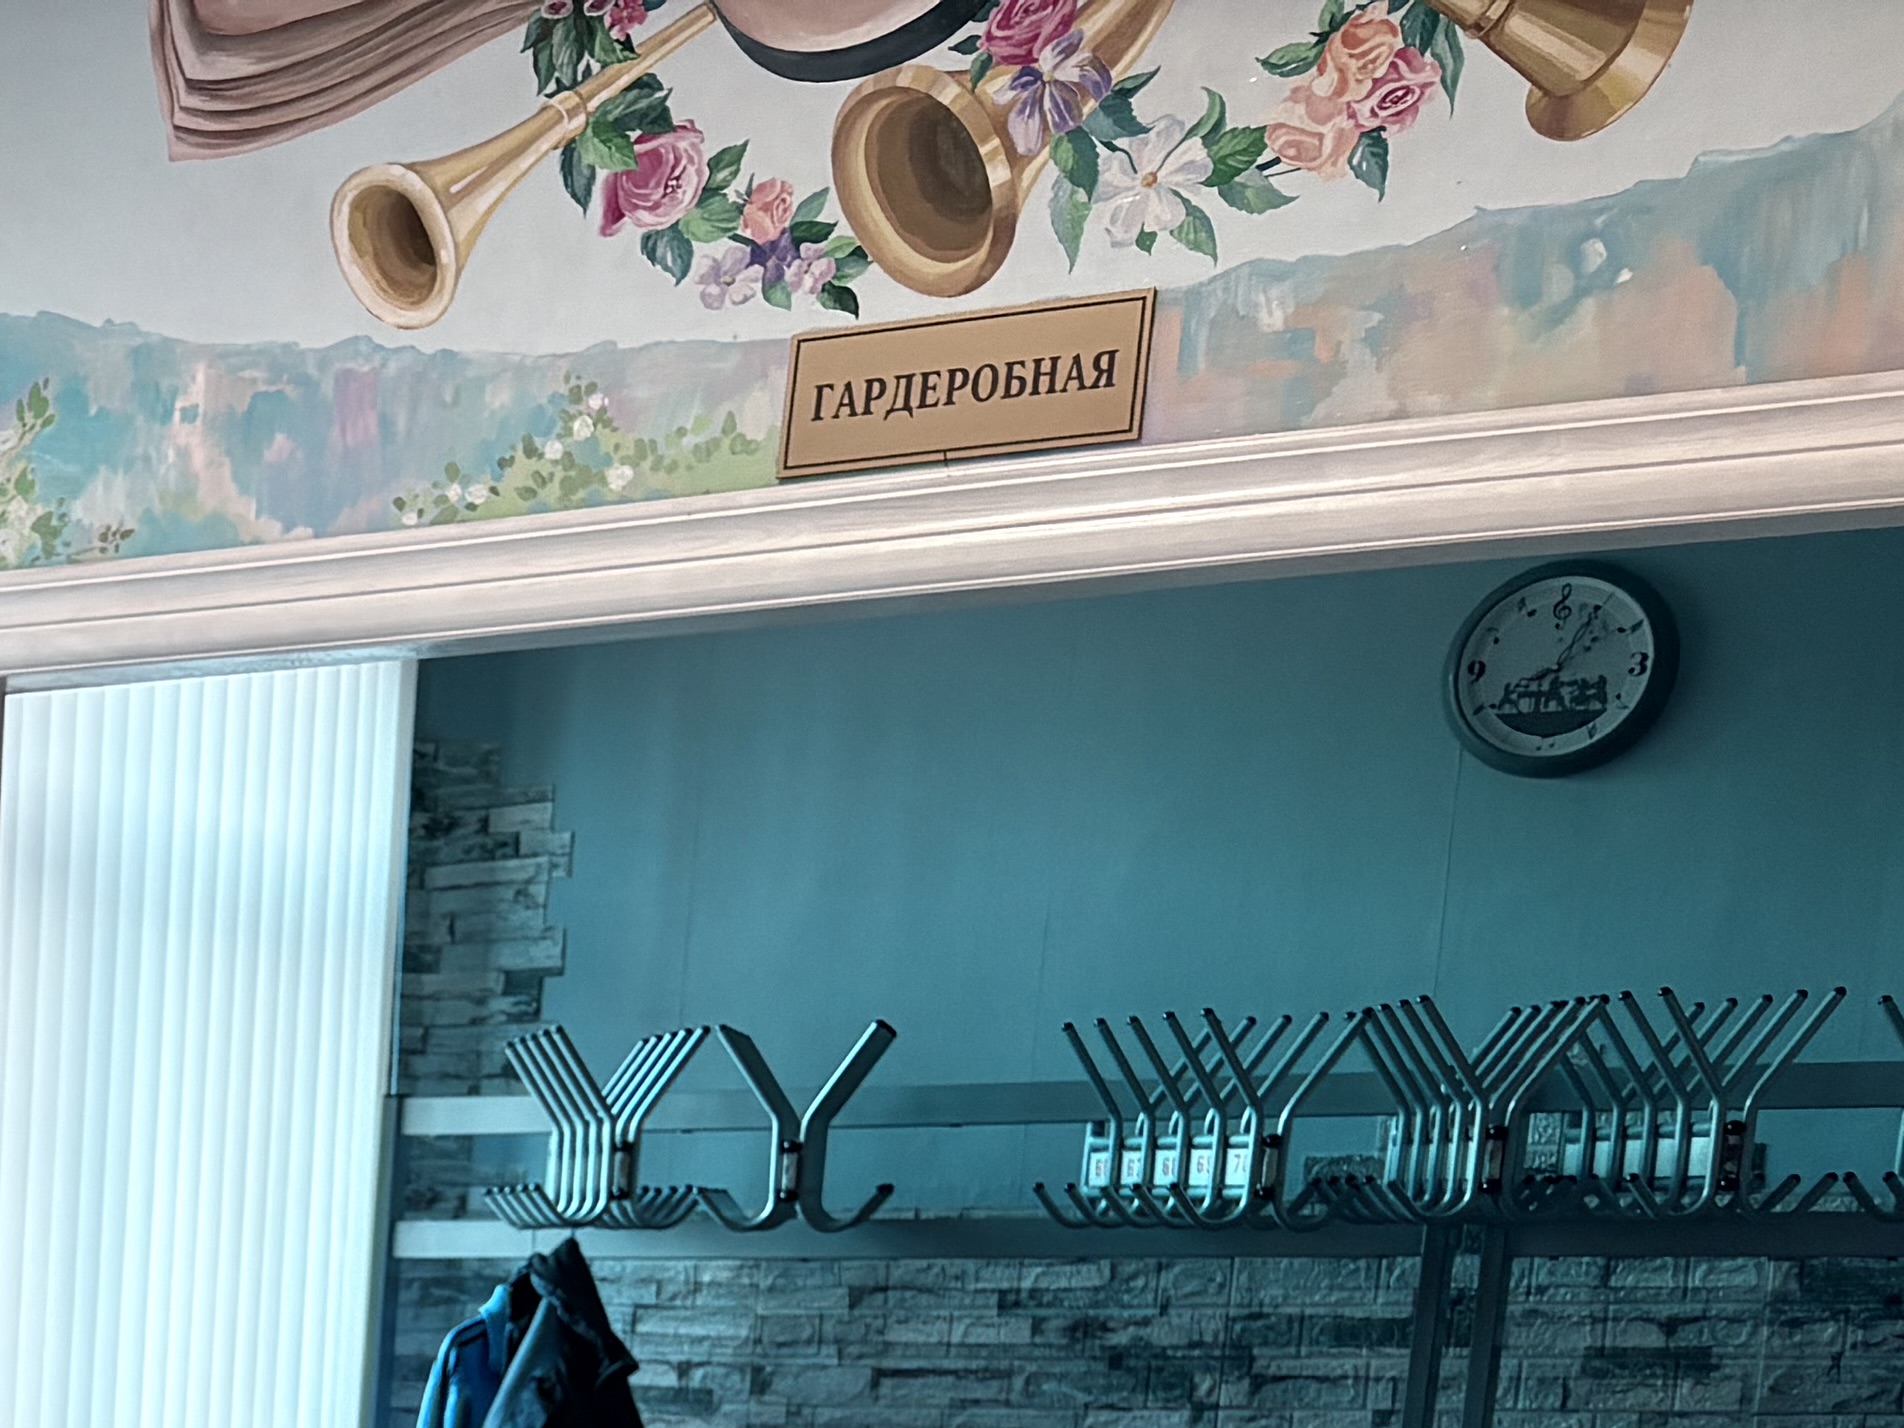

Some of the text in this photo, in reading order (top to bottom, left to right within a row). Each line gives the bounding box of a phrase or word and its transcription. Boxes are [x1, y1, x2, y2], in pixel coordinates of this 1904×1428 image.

[810, 348, 1120, 422] ГАРДЕРОБНАЯ
[1467, 660, 1487, 684] 9
[1628, 652, 1649, 677] 3
